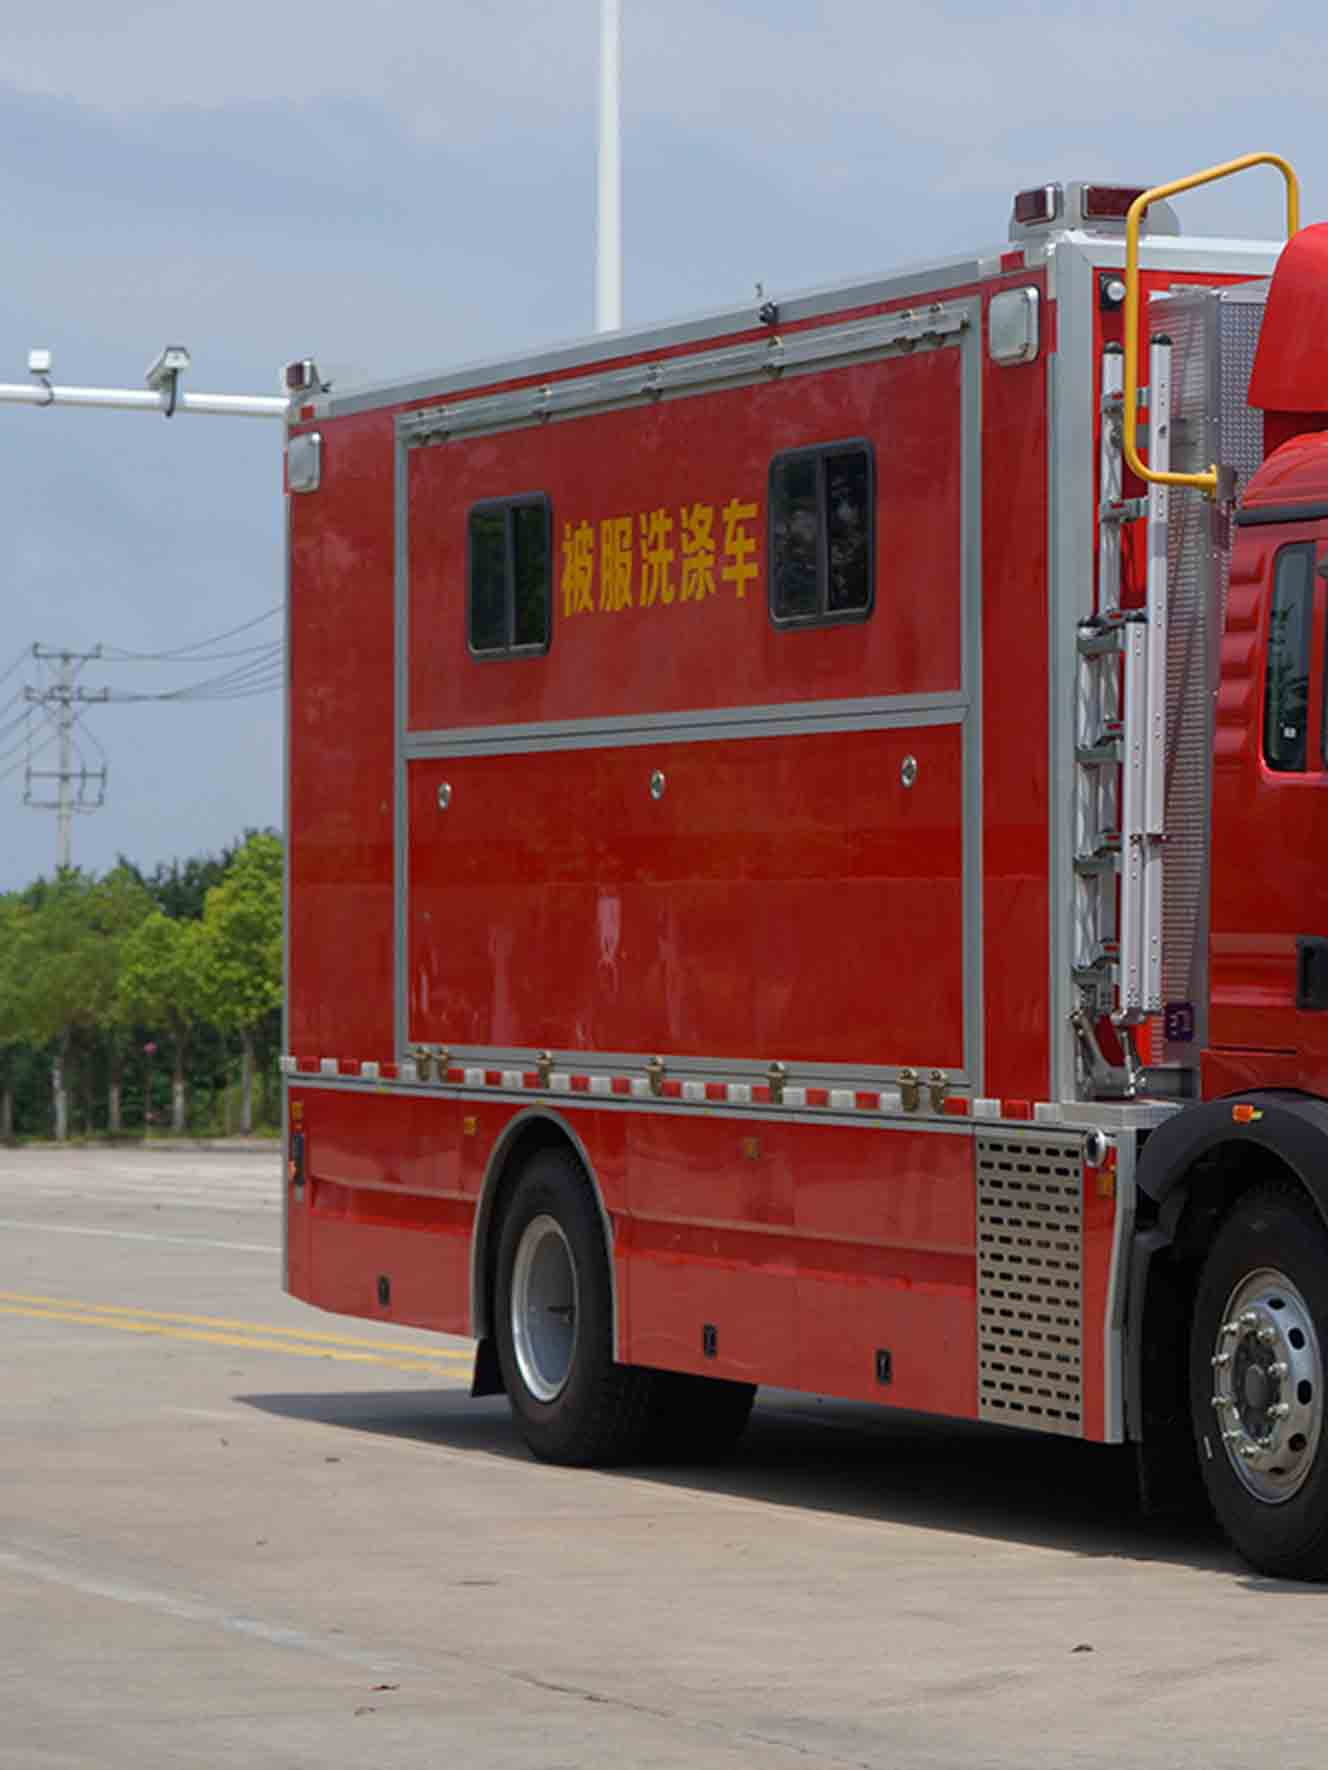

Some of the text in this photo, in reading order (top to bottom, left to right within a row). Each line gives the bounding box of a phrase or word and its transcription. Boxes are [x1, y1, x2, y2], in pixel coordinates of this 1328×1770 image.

[561, 498, 758, 617] 被服洗涤车
